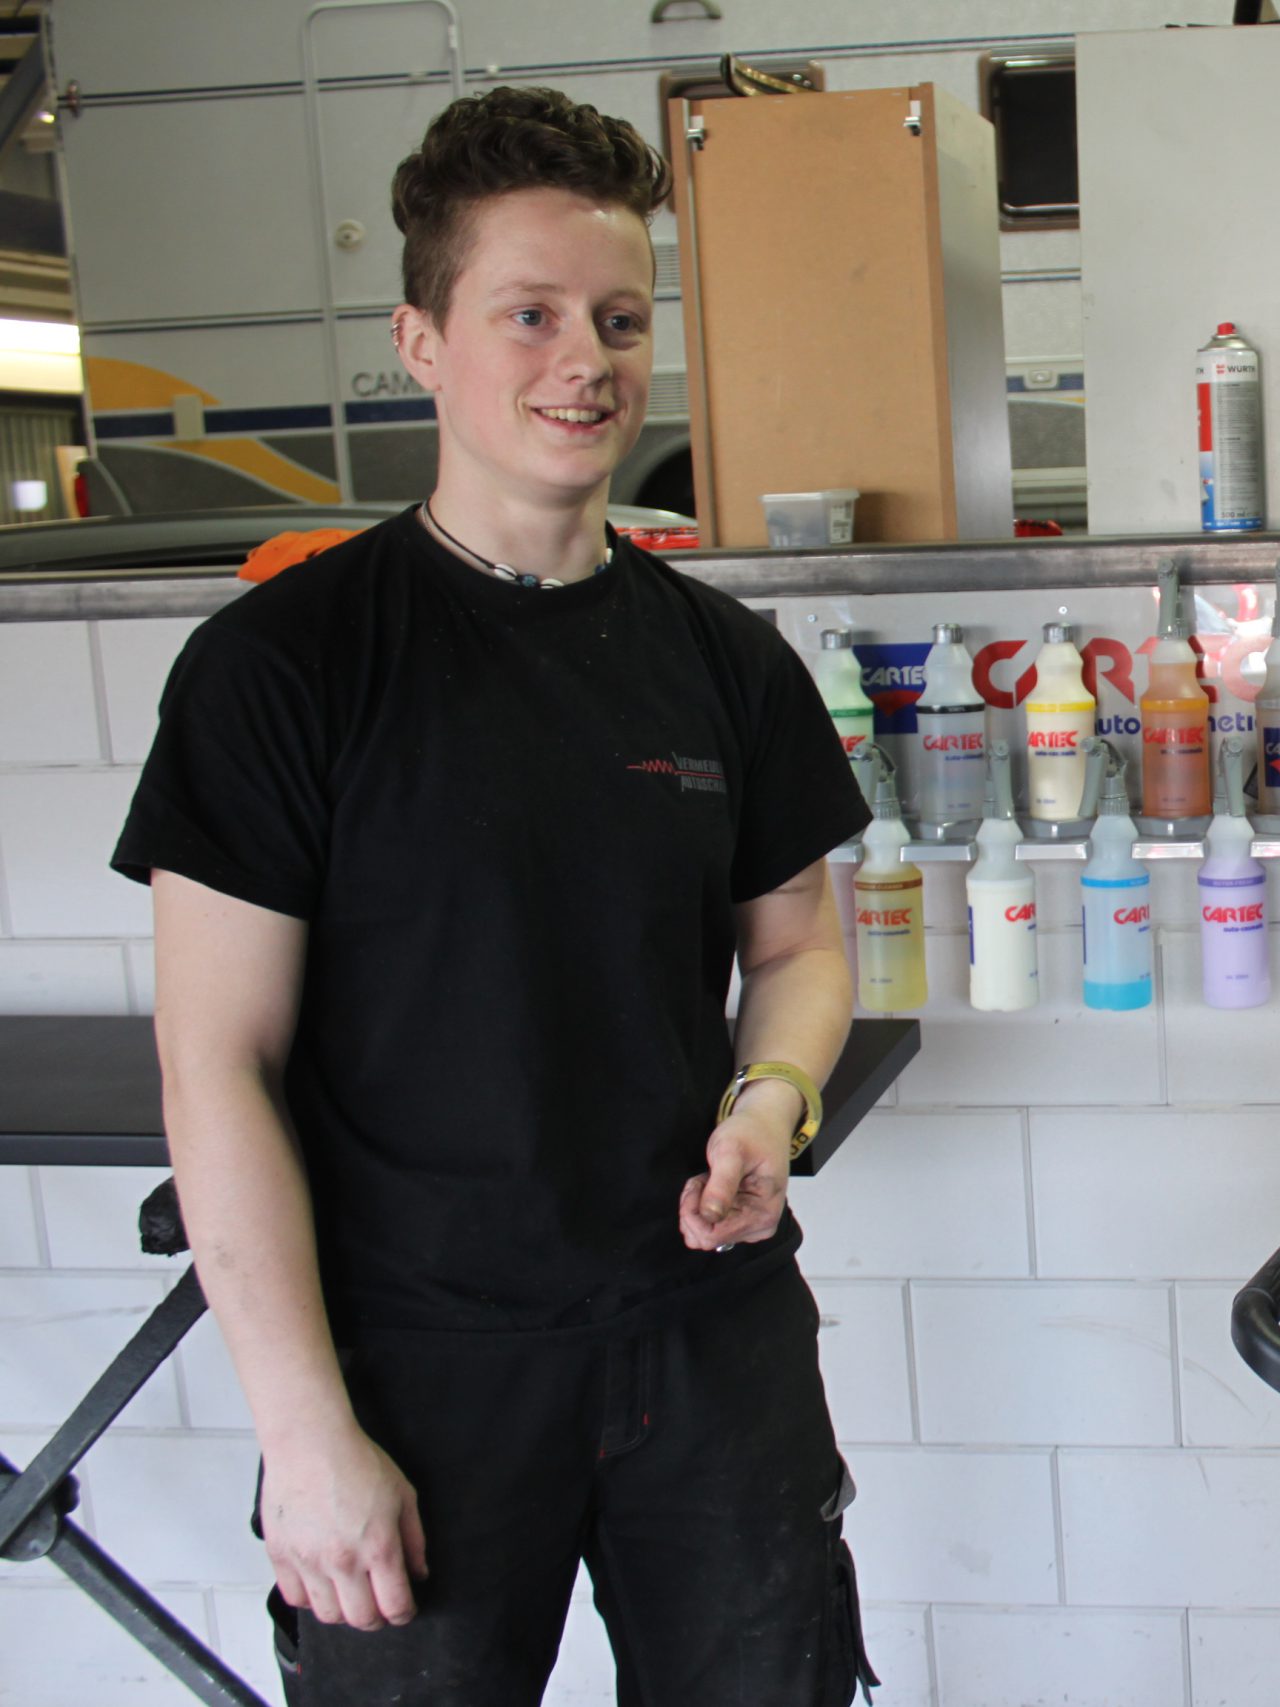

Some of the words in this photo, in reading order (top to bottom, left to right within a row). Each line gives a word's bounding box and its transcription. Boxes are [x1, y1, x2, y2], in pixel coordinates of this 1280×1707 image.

[860, 665, 928, 686] CARTE
[923, 733, 984, 752] CARTEC
[1143, 726, 1205, 746] CARTEC
[1202, 903, 1264, 923] CARTEC
